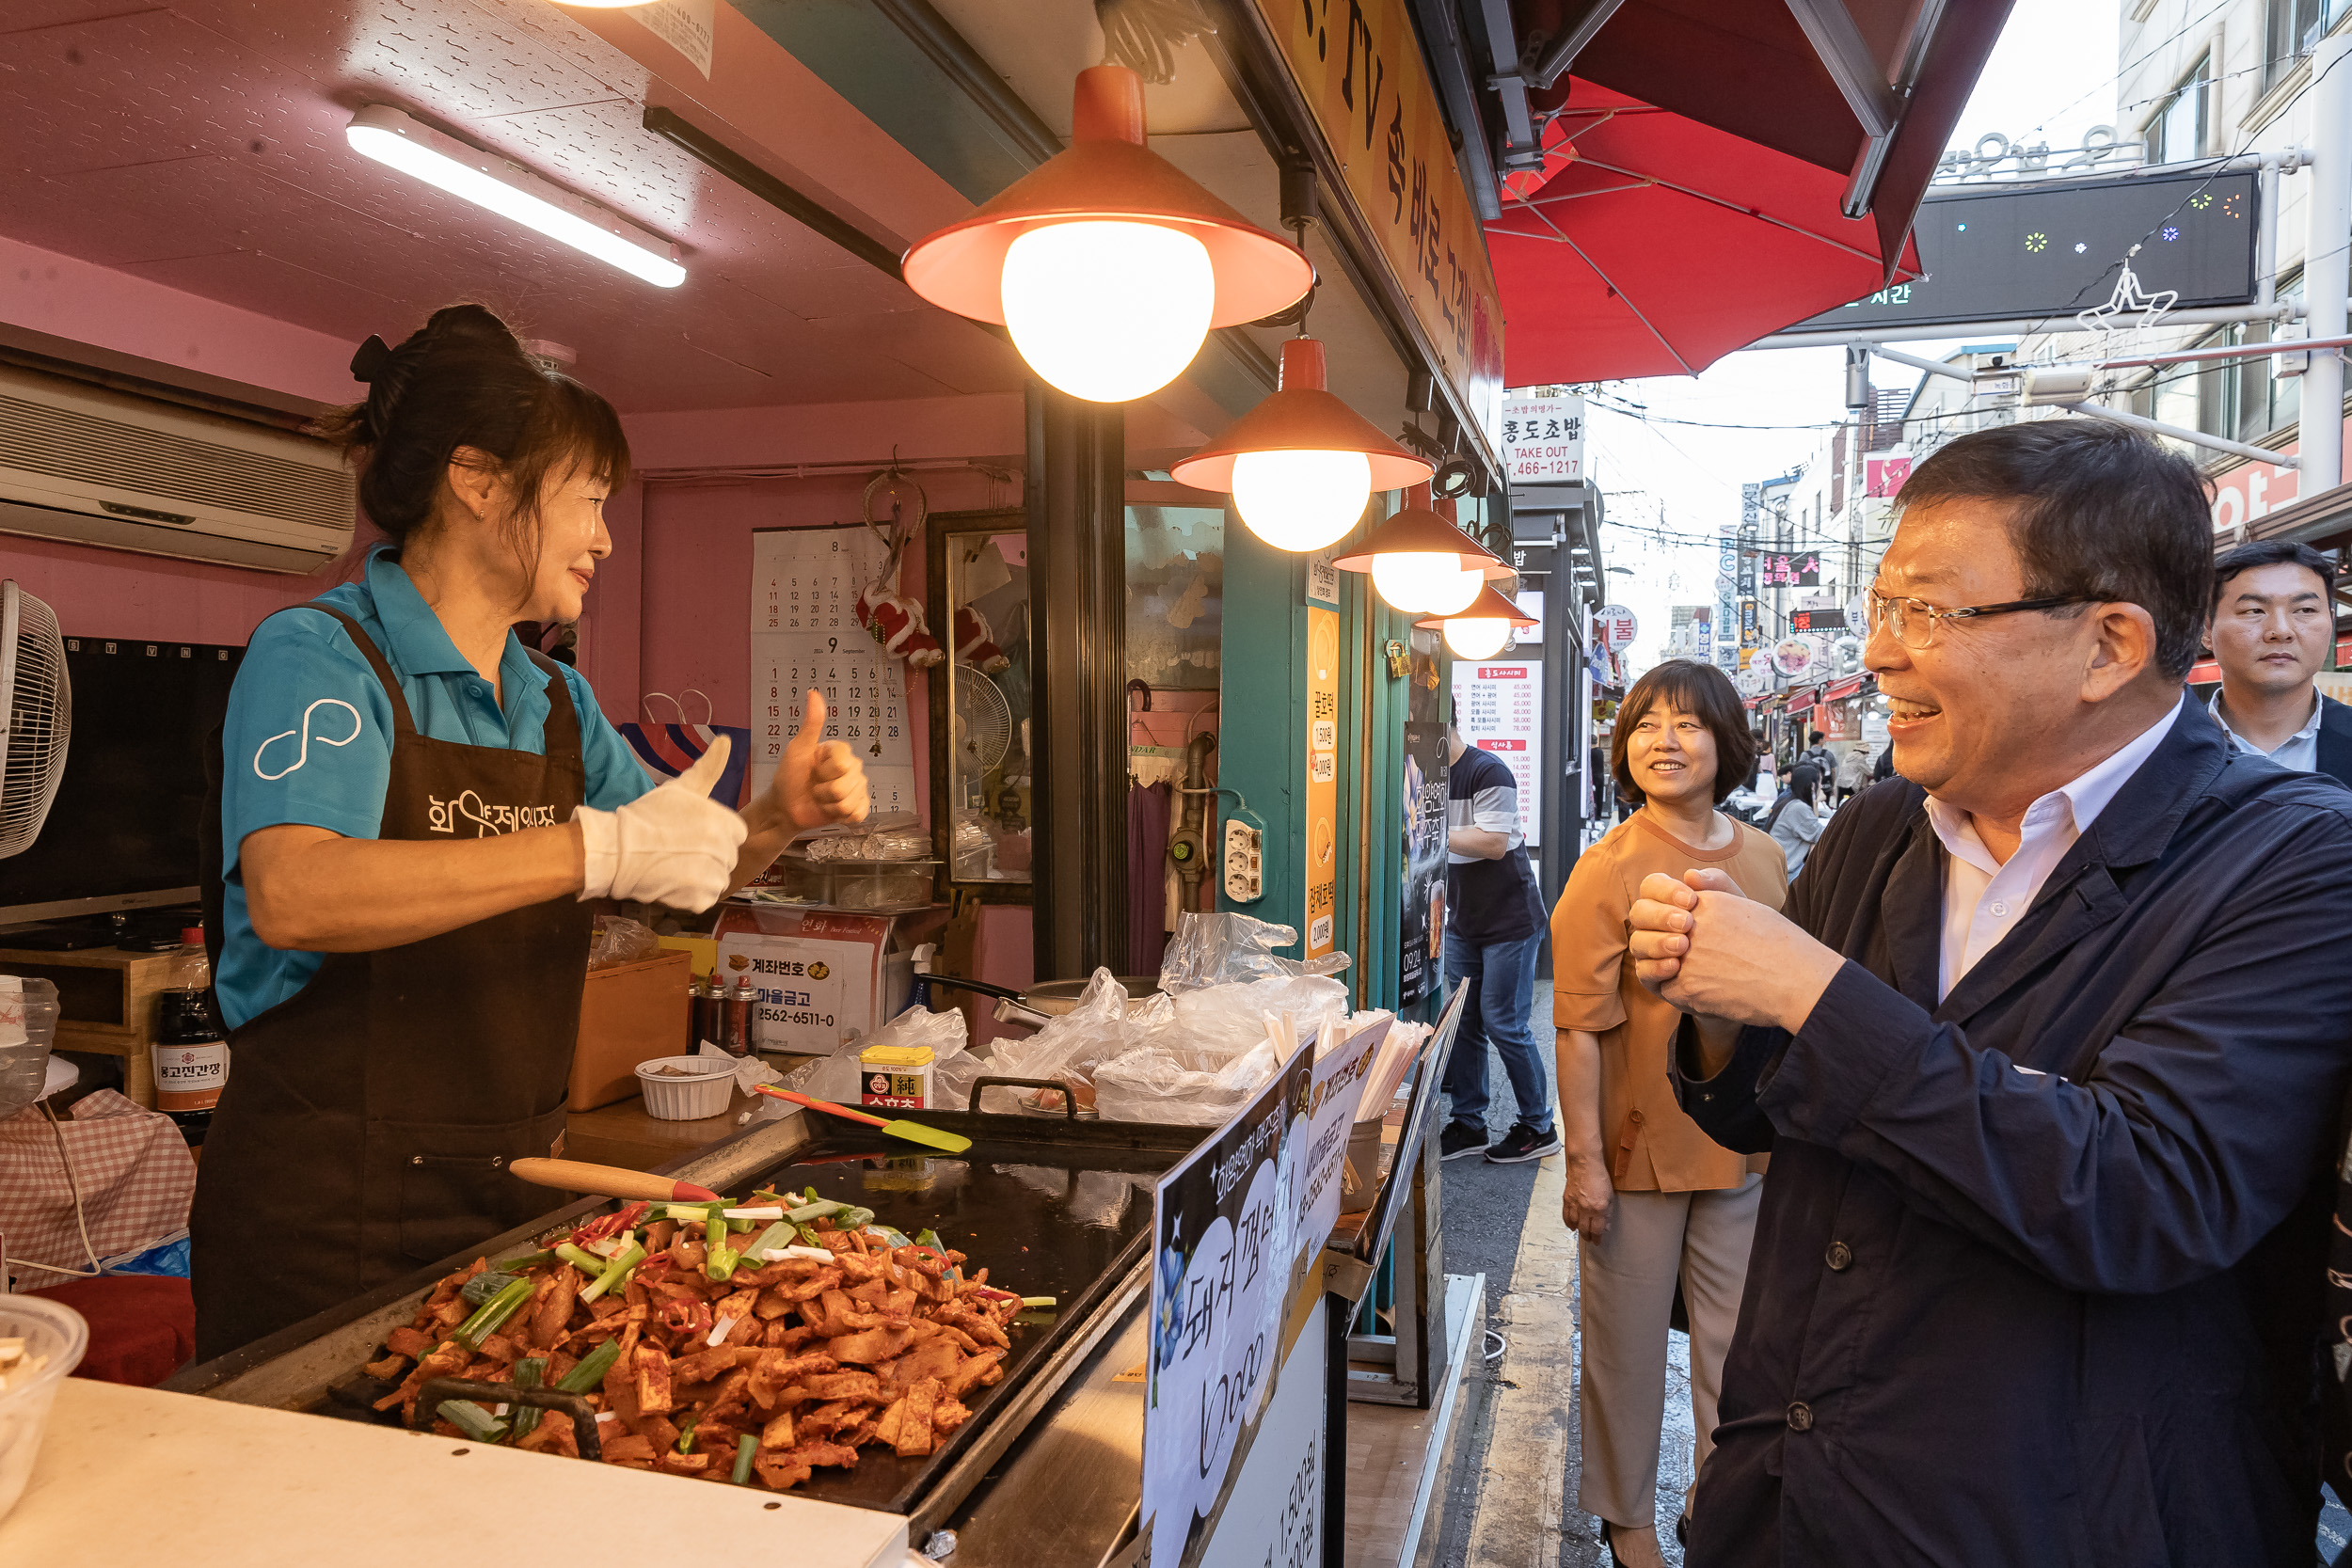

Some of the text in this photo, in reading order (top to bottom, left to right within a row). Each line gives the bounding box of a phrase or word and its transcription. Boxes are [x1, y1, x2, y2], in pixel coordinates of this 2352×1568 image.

[1870, 284, 1911, 305] 시간
[1502, 417, 1581, 443] 홍도초밥
[1515, 446, 1568, 459] TAKE OUT
[832, 541, 838, 552] 8
[864, 562, 867, 571] 2
[792, 578, 797, 586] 5
[813, 578, 818, 586] 6
[832, 578, 837, 586] 7
[769, 592, 777, 600] 11
[790, 592, 799, 600] 12
[812, 592, 819, 600] 13
[851, 591, 858, 599] 15
[769, 605, 778, 613] 18
[791, 605, 799, 613] 19
[811, 605, 819, 613] 20
[769, 619, 778, 627] 25
[790, 619, 799, 627] 26
[811, 619, 818, 627] 27
[829, 618, 839, 626] 28
[850, 618, 859, 626] 29
[828, 637, 837, 653] 9
[772, 668, 892, 679] 1 2 3 4 5 6 7
[771, 687, 777, 698] 8
[791, 687, 797, 698] 9
[827, 687, 836, 698] 11
[849, 687, 861, 698] 12
[869, 687, 879, 698] 13
[1315, 690, 1333, 719] 꿀호떡
[768, 705, 897, 718] 15 16 18 19 20 21
[768, 725, 898, 736] 22 23 25 26 27 28
[768, 743, 780, 754] 29
[893, 792, 898, 800] 5
[1310, 880, 1334, 914] 잡채호떡
[1313, 919, 1329, 943] 2,000원
[753, 958, 804, 976] 계좌번호
[161, 1063, 220, 1078] 몽고진간장
[1216, 1133, 1255, 1205] 화양연화
[1280, 1429, 1316, 1557] 1,500원
